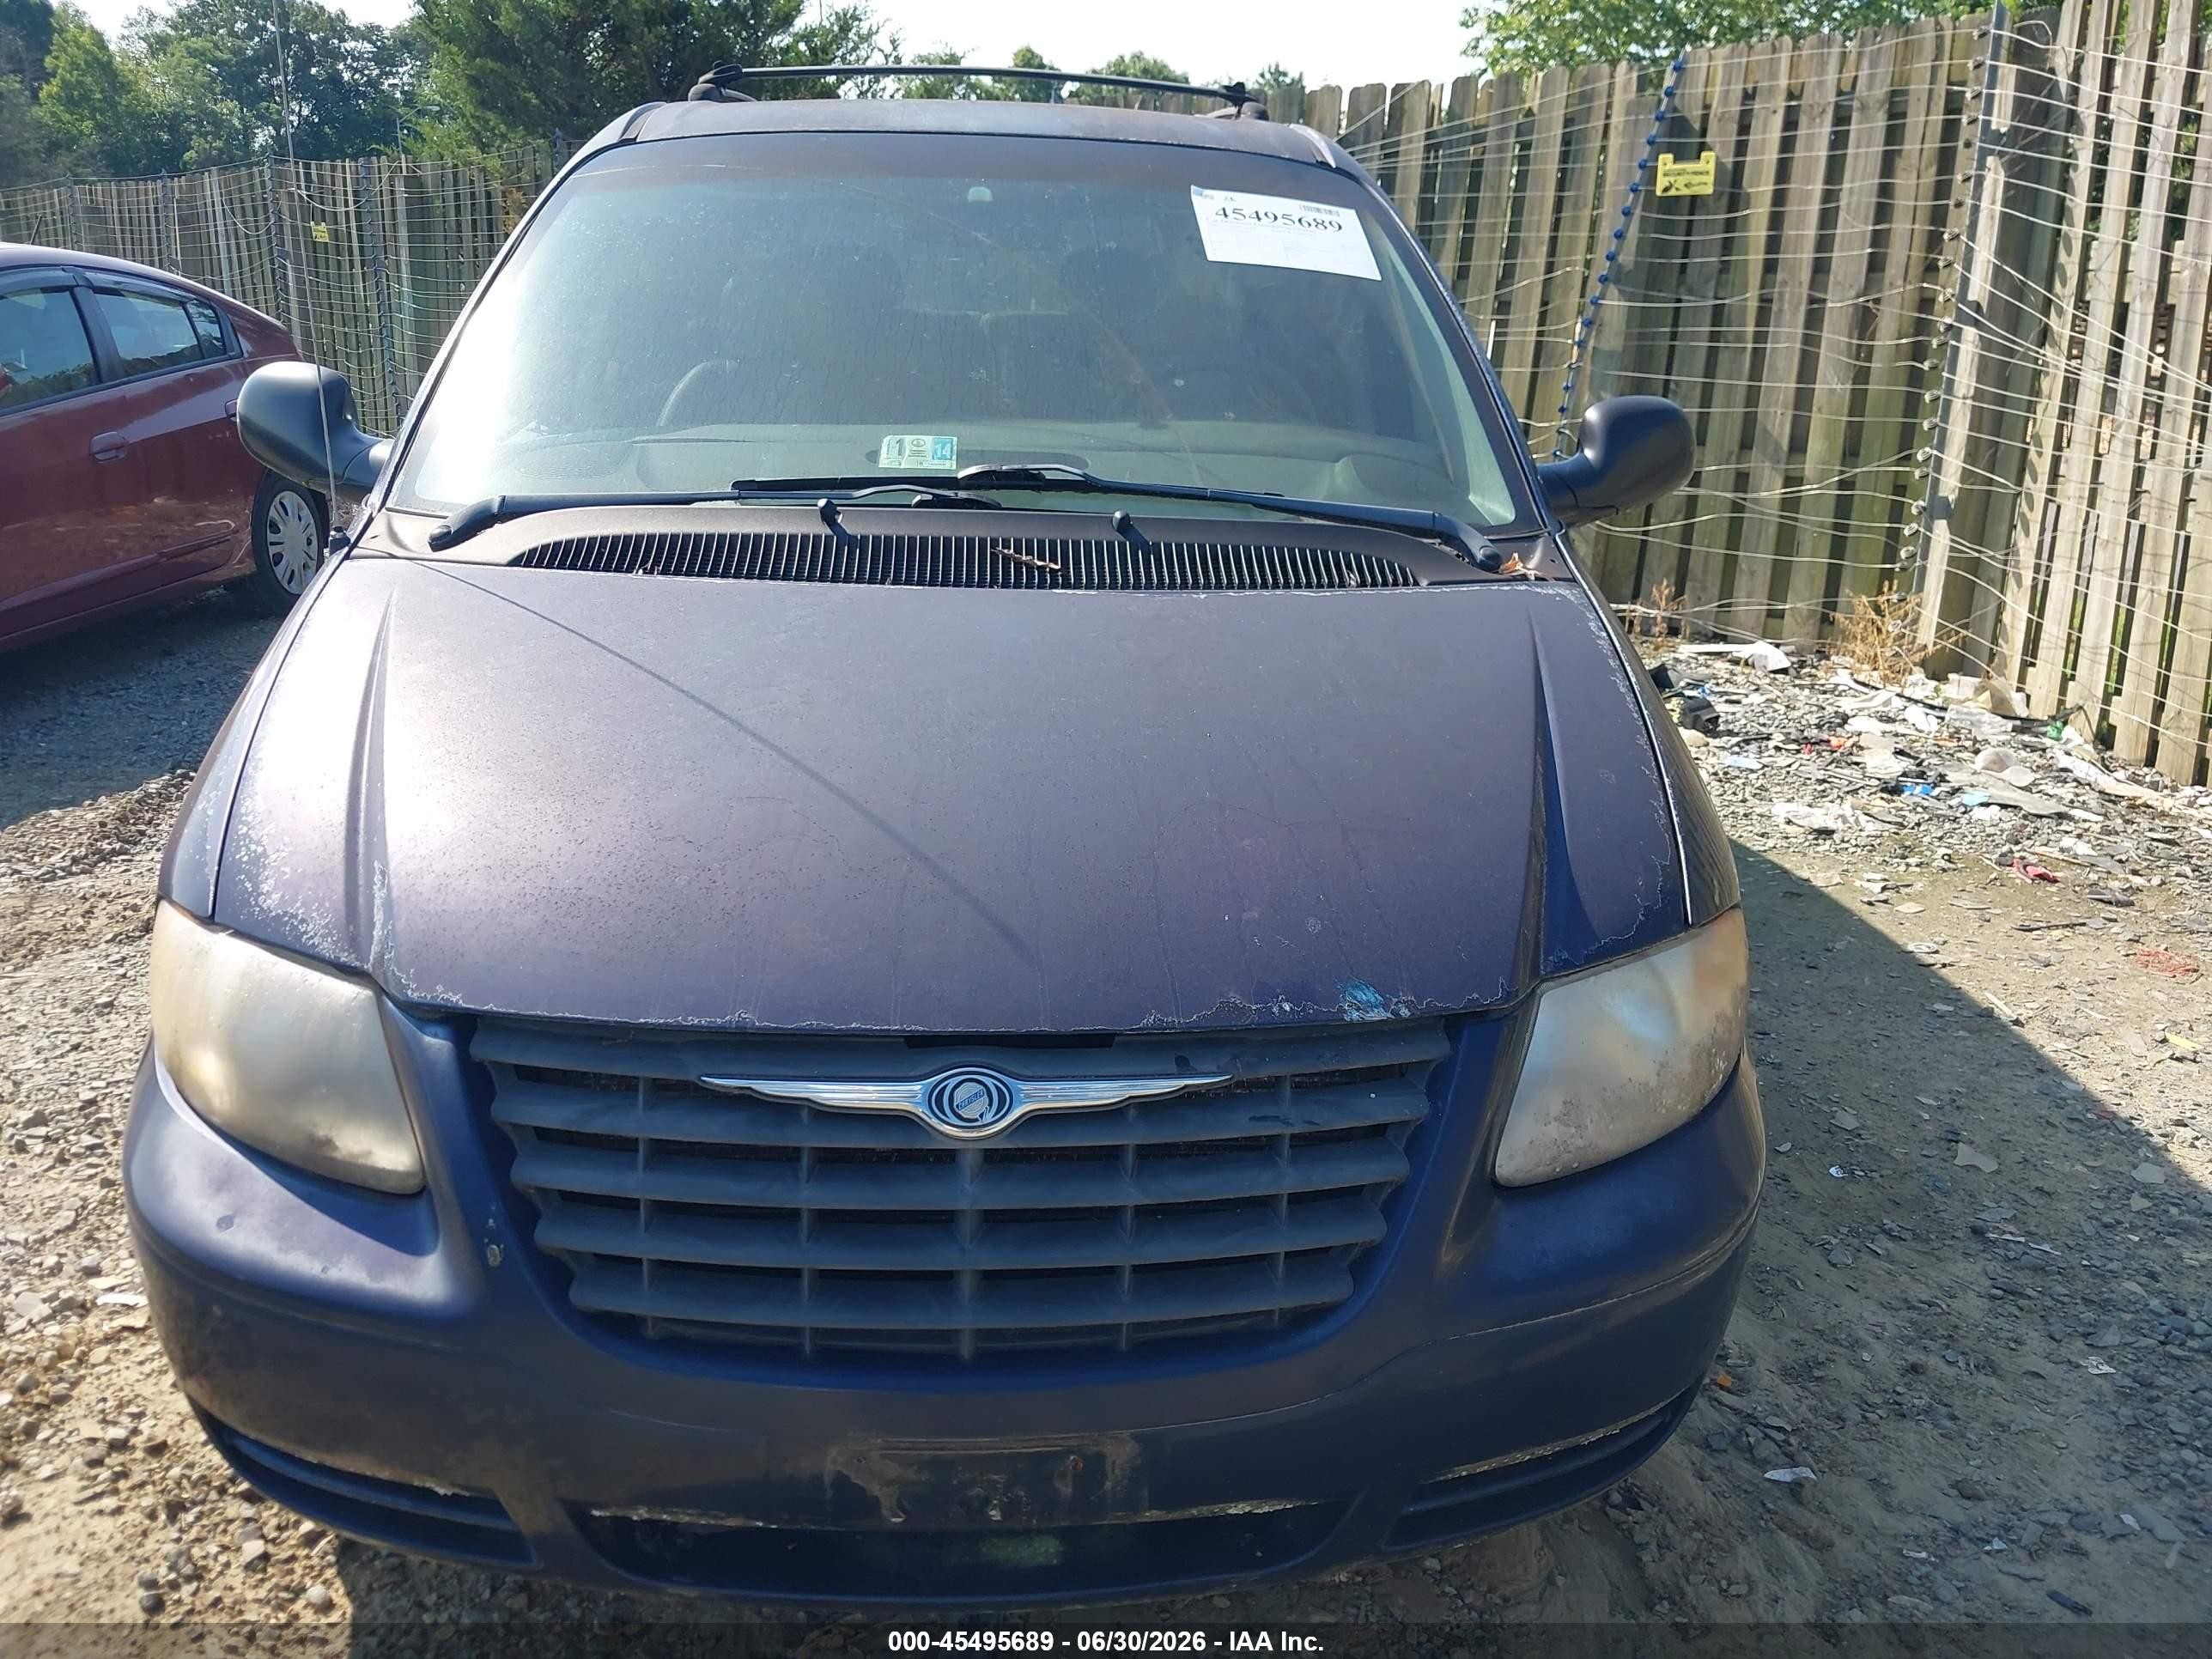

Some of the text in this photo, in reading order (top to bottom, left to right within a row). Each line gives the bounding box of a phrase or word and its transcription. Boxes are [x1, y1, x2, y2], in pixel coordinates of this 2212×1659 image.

[1215, 206, 1343, 233] 45495689
[934, 443, 951, 458] 14
[958, 1090, 984, 1109] CHRYSLER
